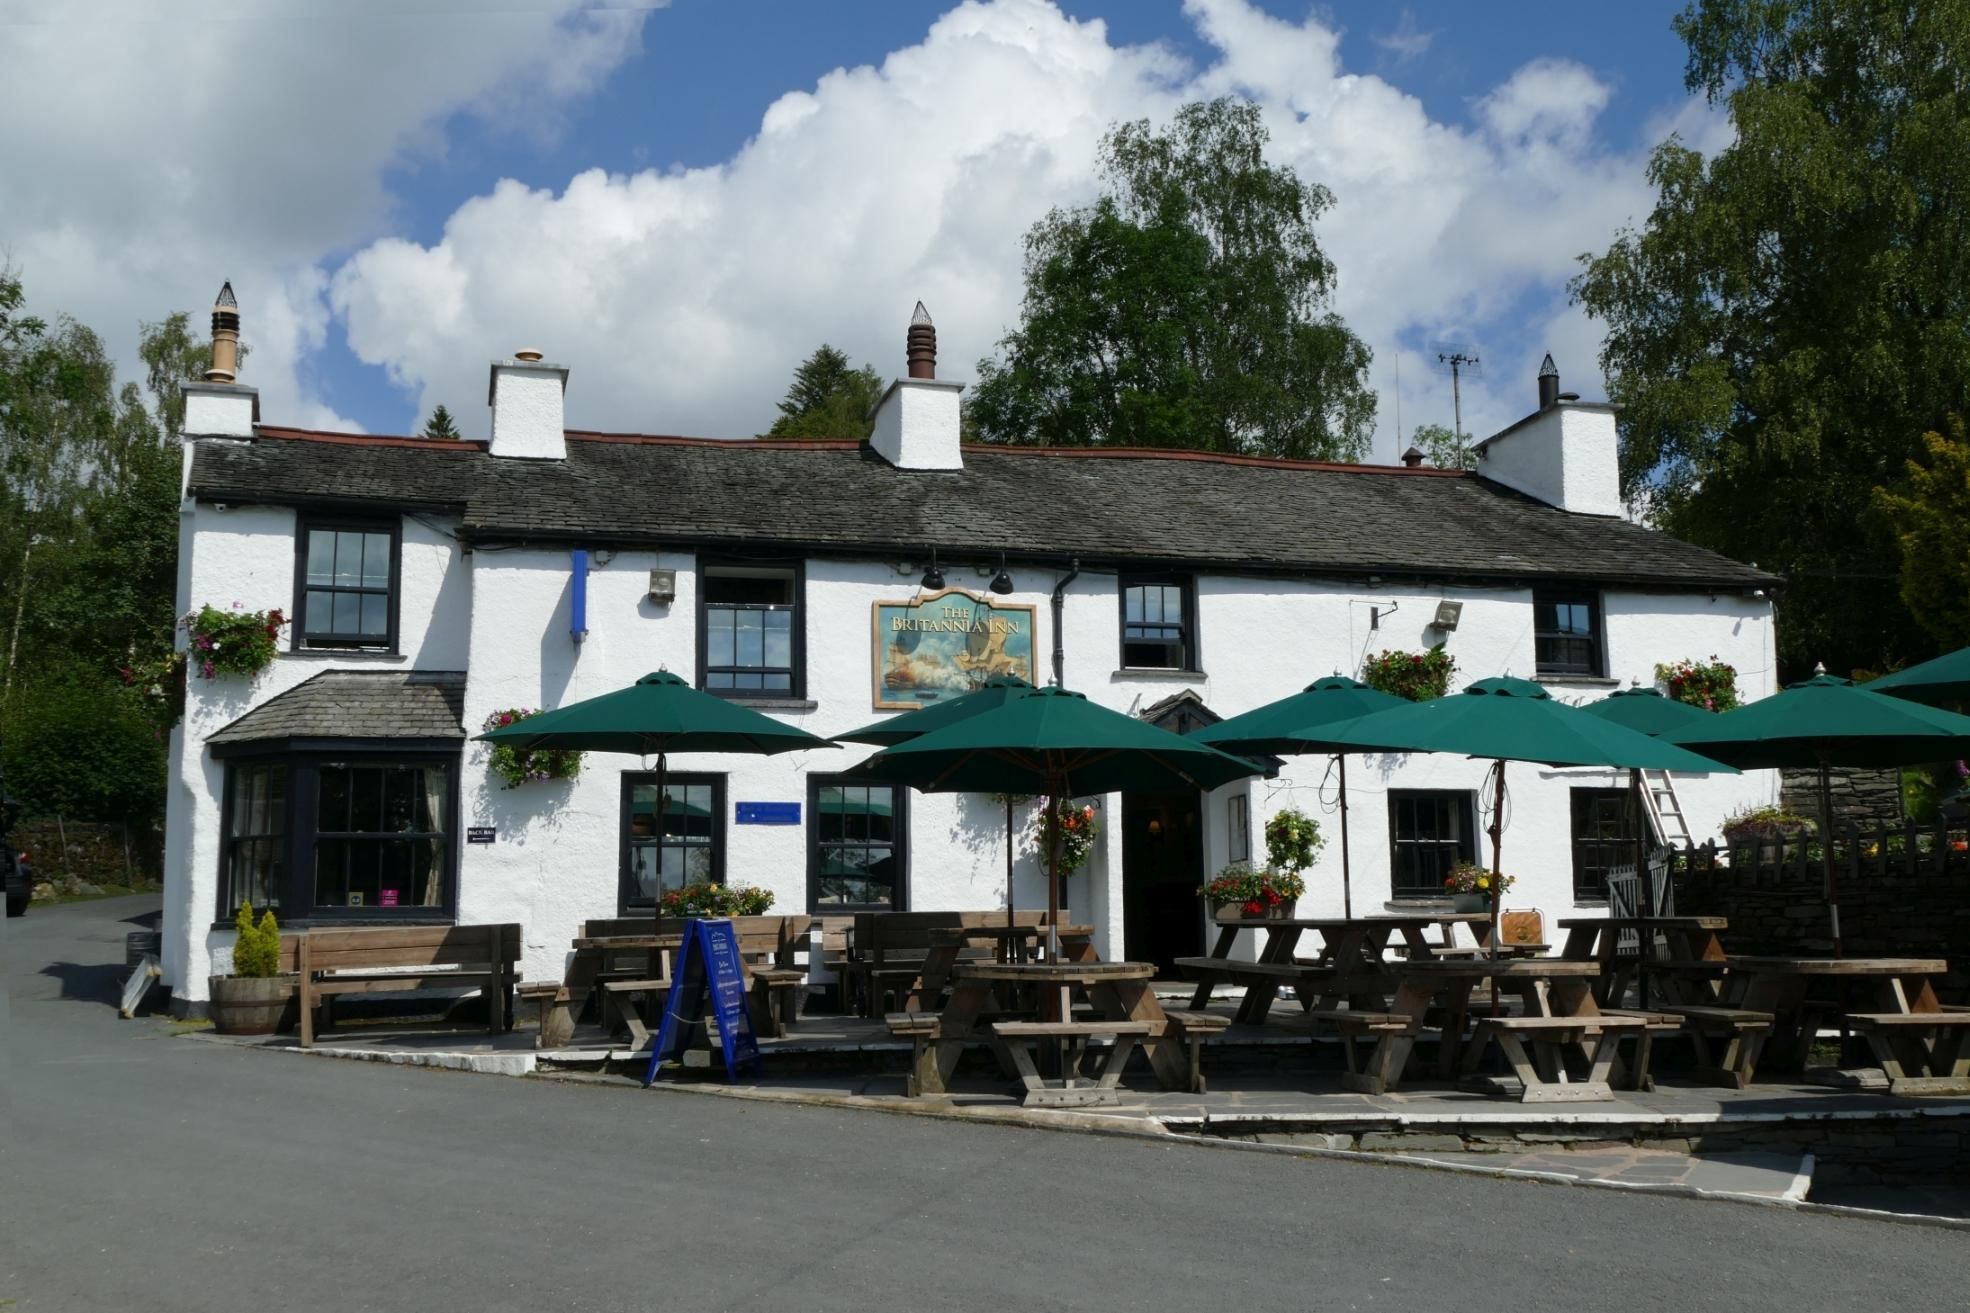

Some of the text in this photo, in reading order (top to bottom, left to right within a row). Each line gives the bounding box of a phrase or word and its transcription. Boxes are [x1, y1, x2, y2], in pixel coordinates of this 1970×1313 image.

[942, 607, 969, 619] THE
[891, 616, 1019, 634] BRITANNIA INN
